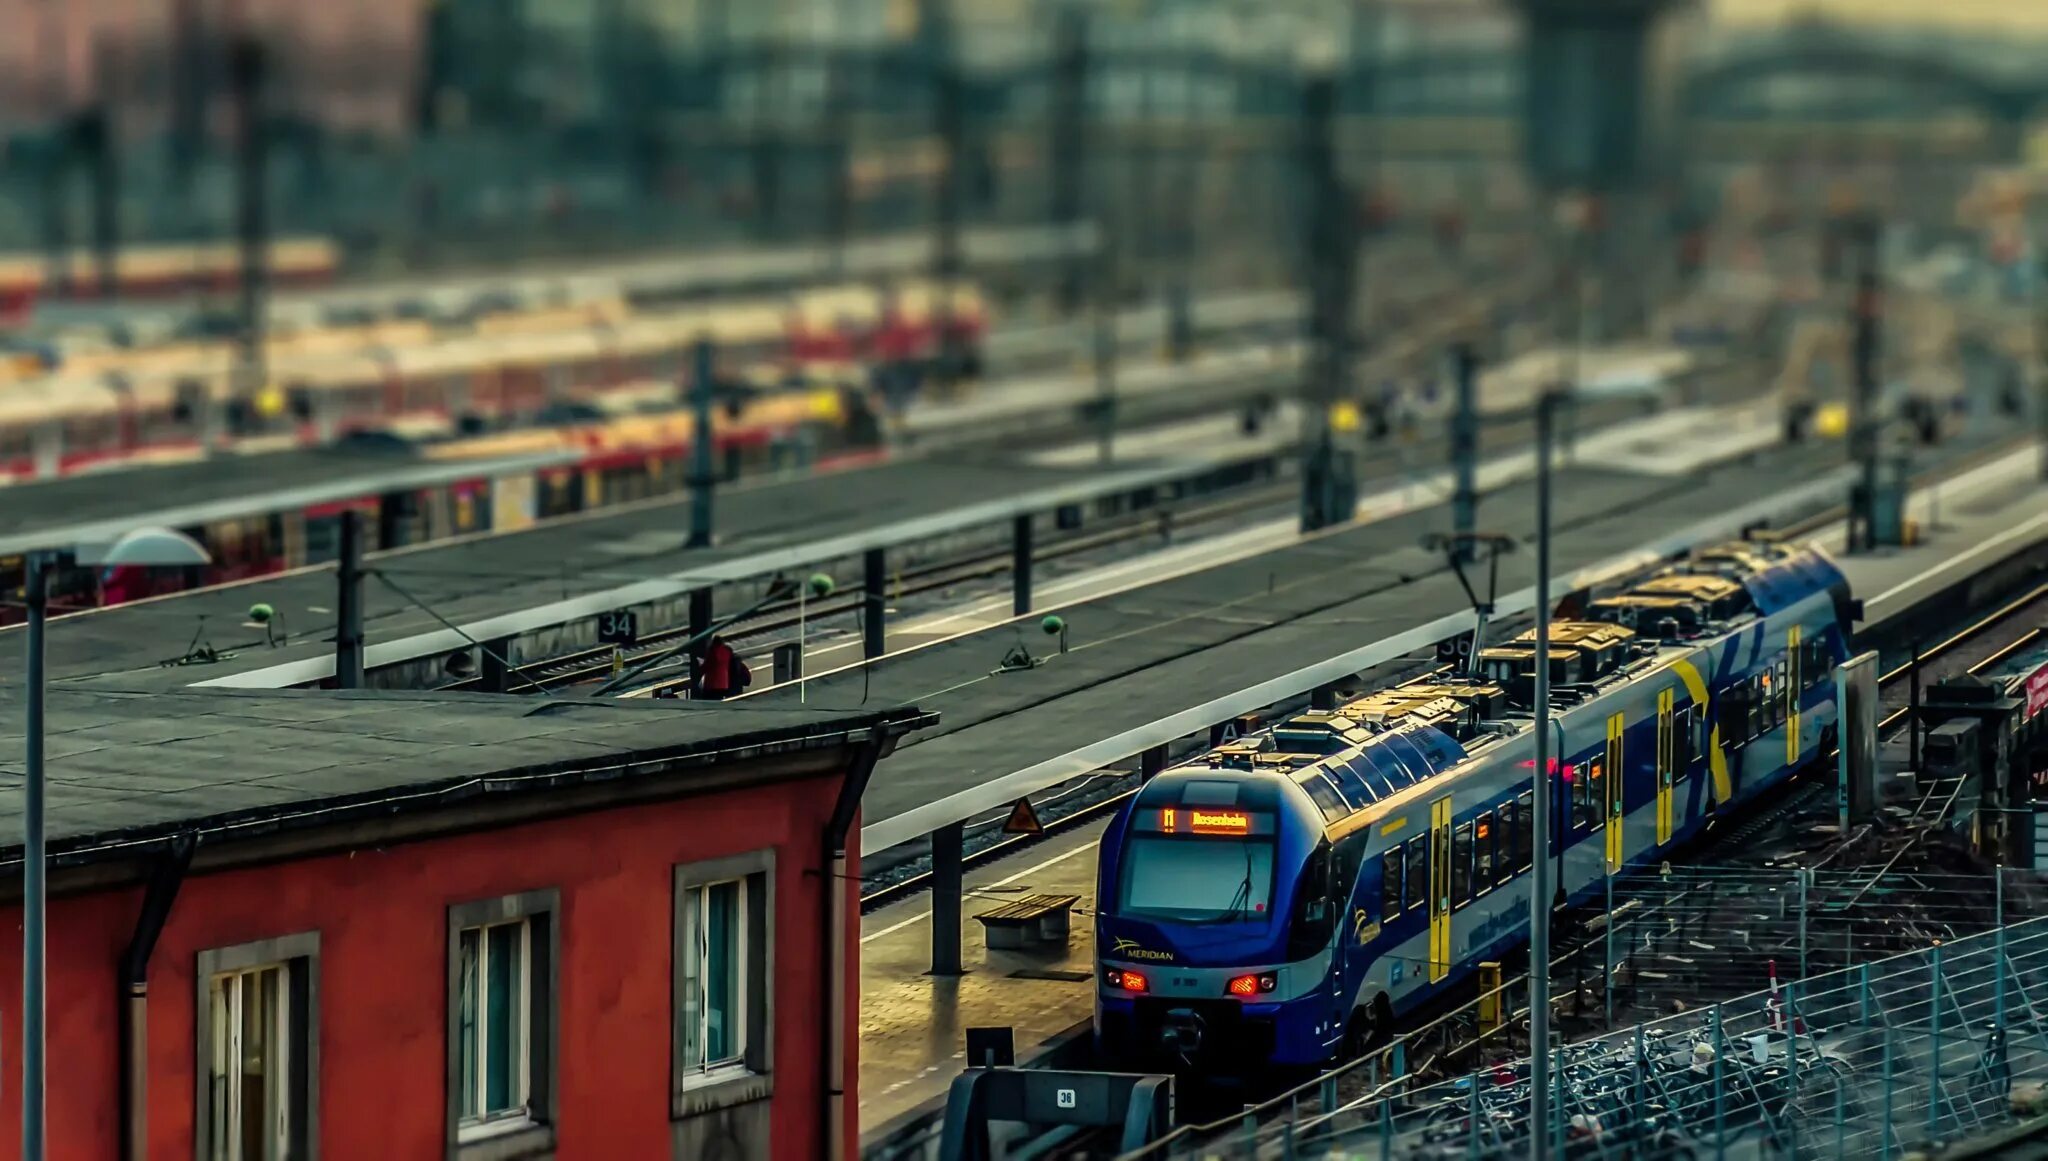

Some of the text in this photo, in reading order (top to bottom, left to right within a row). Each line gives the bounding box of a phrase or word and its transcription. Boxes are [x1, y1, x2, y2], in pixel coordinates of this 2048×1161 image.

[602, 613, 631, 636] 34
[1219, 722, 1239, 746] A
[1192, 811, 1247, 827] Rosenheim
[1127, 950, 1174, 961] MERIDIAN
[1060, 1091, 1072, 1104] 36
